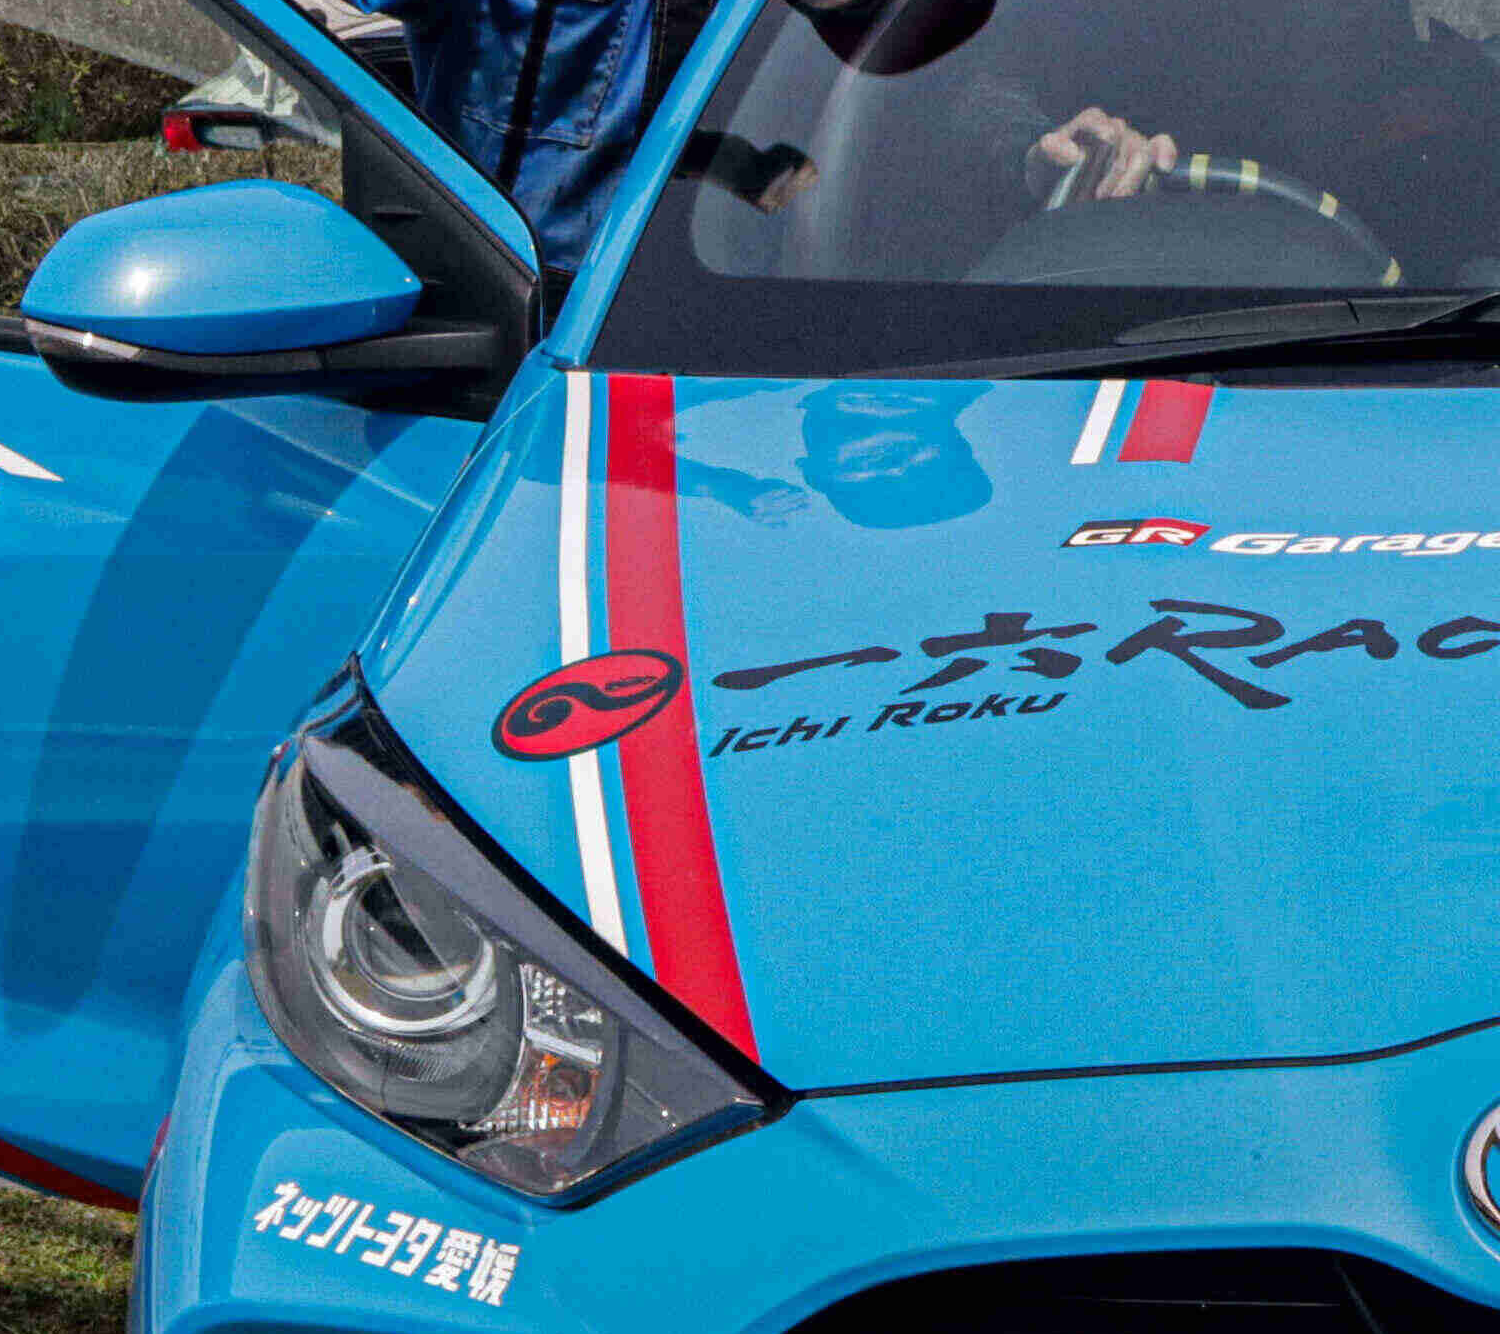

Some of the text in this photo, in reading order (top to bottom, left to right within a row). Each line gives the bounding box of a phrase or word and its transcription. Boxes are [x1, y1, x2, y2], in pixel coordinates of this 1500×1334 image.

[1062, 518, 1212, 549] GR
[867, 691, 1068, 732] Roku
[253, 1181, 521, 1306] ネッツトヨタ愛媛
